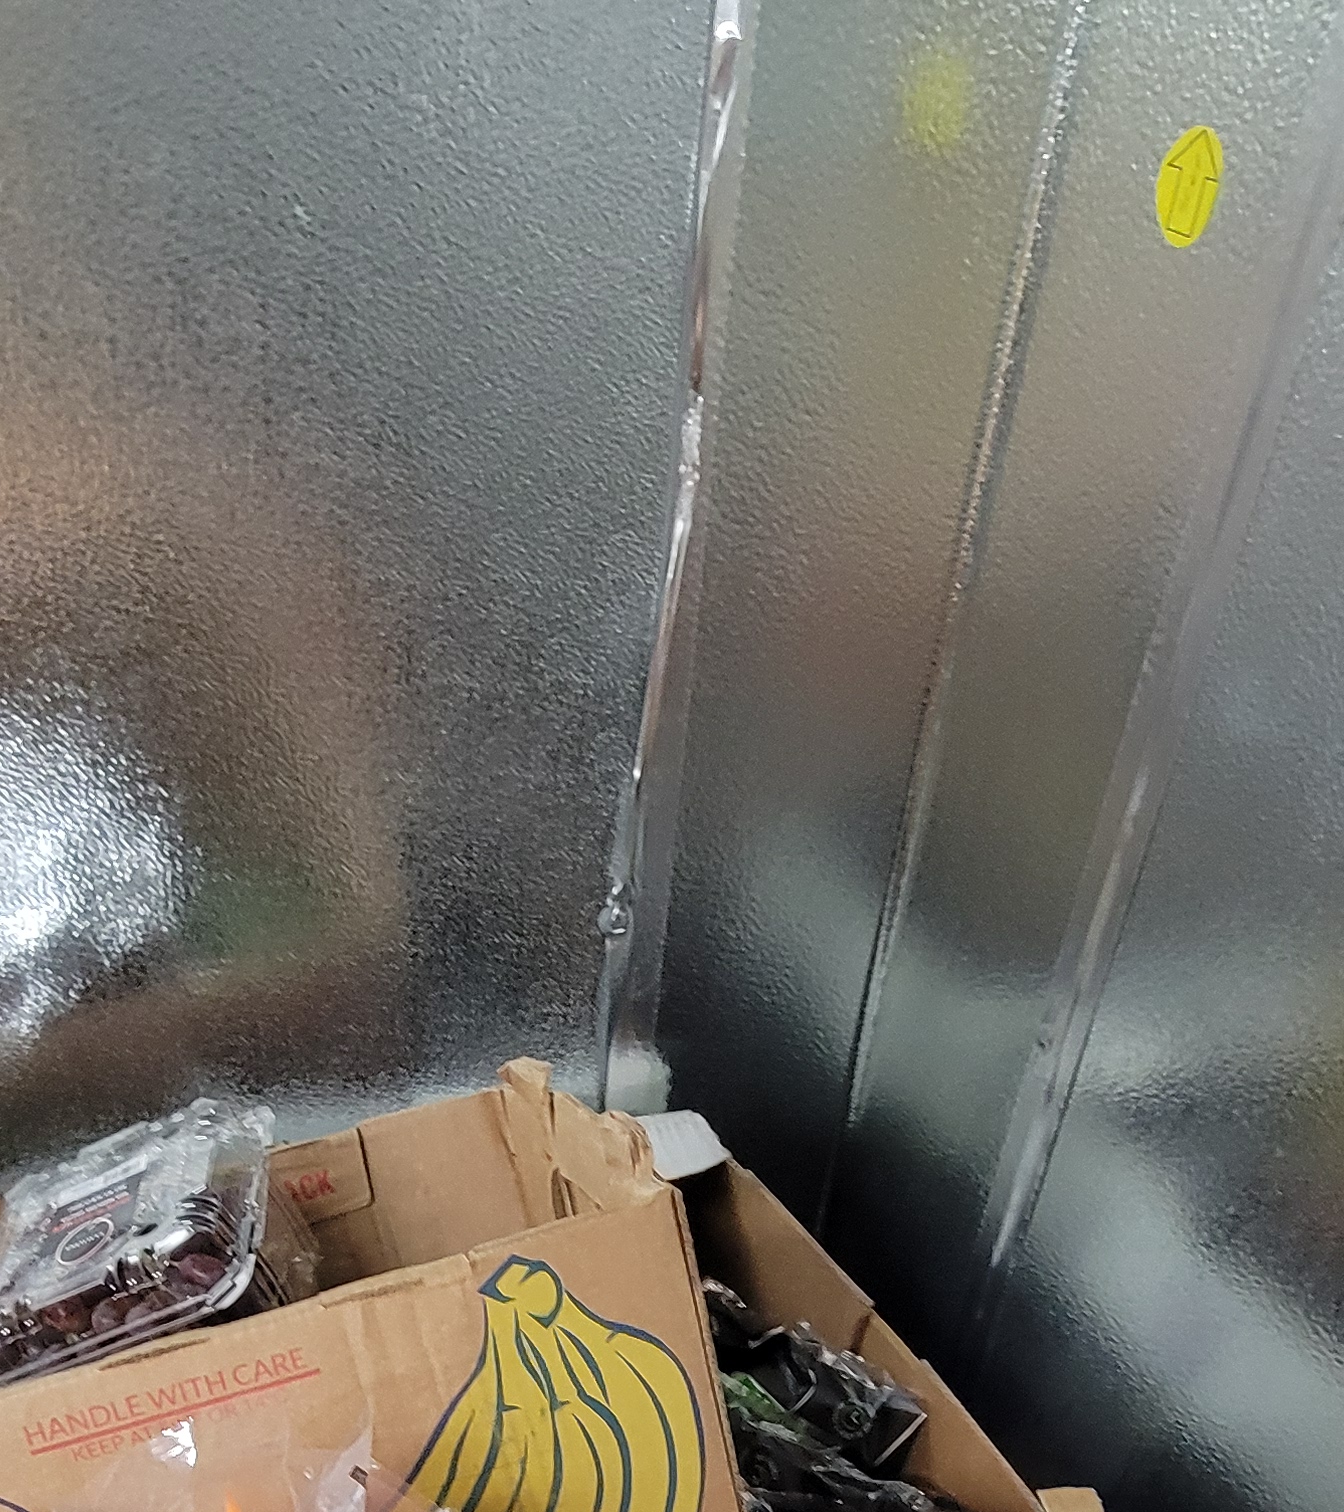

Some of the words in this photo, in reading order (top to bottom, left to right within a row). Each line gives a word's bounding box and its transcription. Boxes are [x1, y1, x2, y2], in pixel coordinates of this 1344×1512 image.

[22, 1393, 145, 1446] HANDLE
[147, 1370, 227, 1411] WITH
[233, 1346, 309, 1386] CARE
[70, 1430, 126, 1462] KEEP
